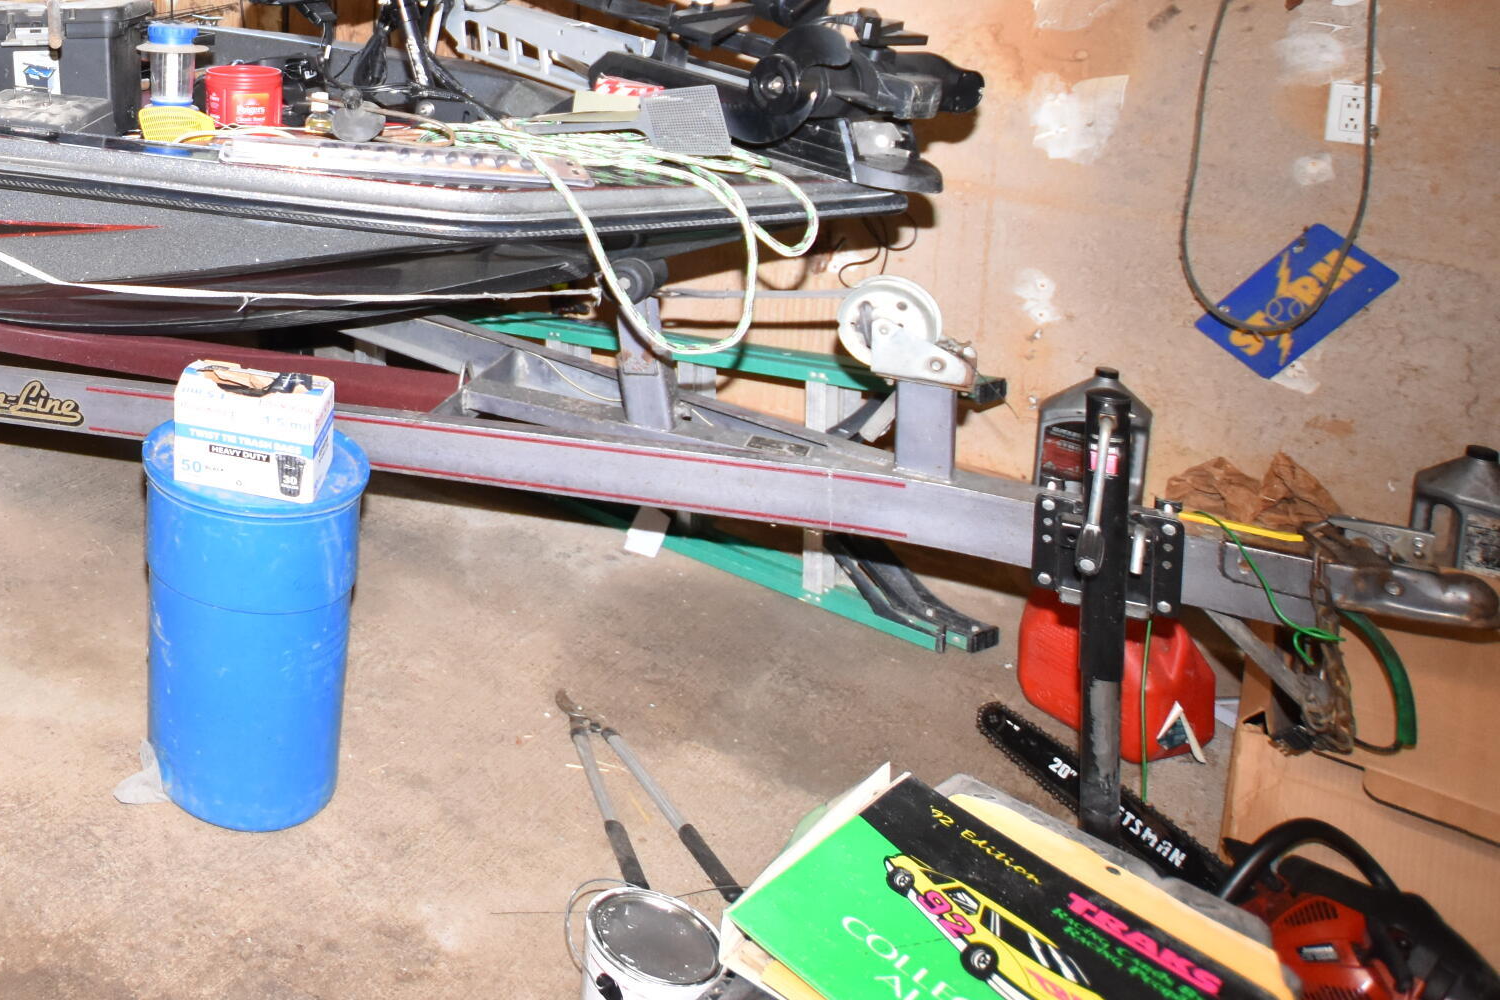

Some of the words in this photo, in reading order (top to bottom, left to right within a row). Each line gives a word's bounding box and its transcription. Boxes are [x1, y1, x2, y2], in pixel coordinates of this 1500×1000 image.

[210, 445, 242, 458] HEAVY
[242, 450, 268, 462] DUTY
[180, 458, 202, 474] 50
[282, 475, 298, 486] 30
[1047, 756, 1078, 780] 20"
[960, 828, 1042, 886] Edition
[916, 889, 976, 939] 92
[1067, 891, 1224, 999] TRAKS
